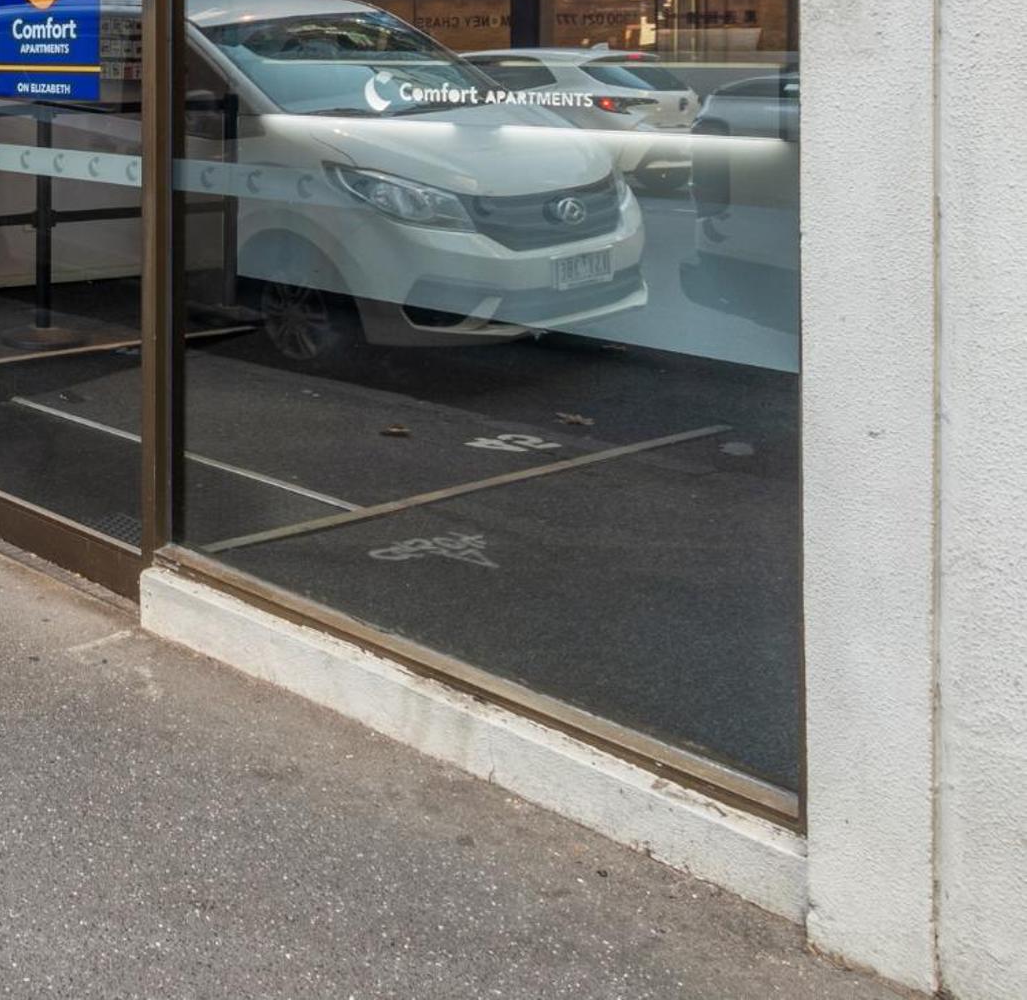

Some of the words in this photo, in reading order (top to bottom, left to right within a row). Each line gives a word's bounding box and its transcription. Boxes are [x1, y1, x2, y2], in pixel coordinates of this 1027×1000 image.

[12, 17, 77, 40] Comfort
[20, 43, 69, 54] APARTMENTS
[17, 82, 29, 92] ON
[30, 83, 71, 94] ELIZABETH
[399, 82, 478, 104] Comfort
[485, 90, 593, 107] APARTMENTS
